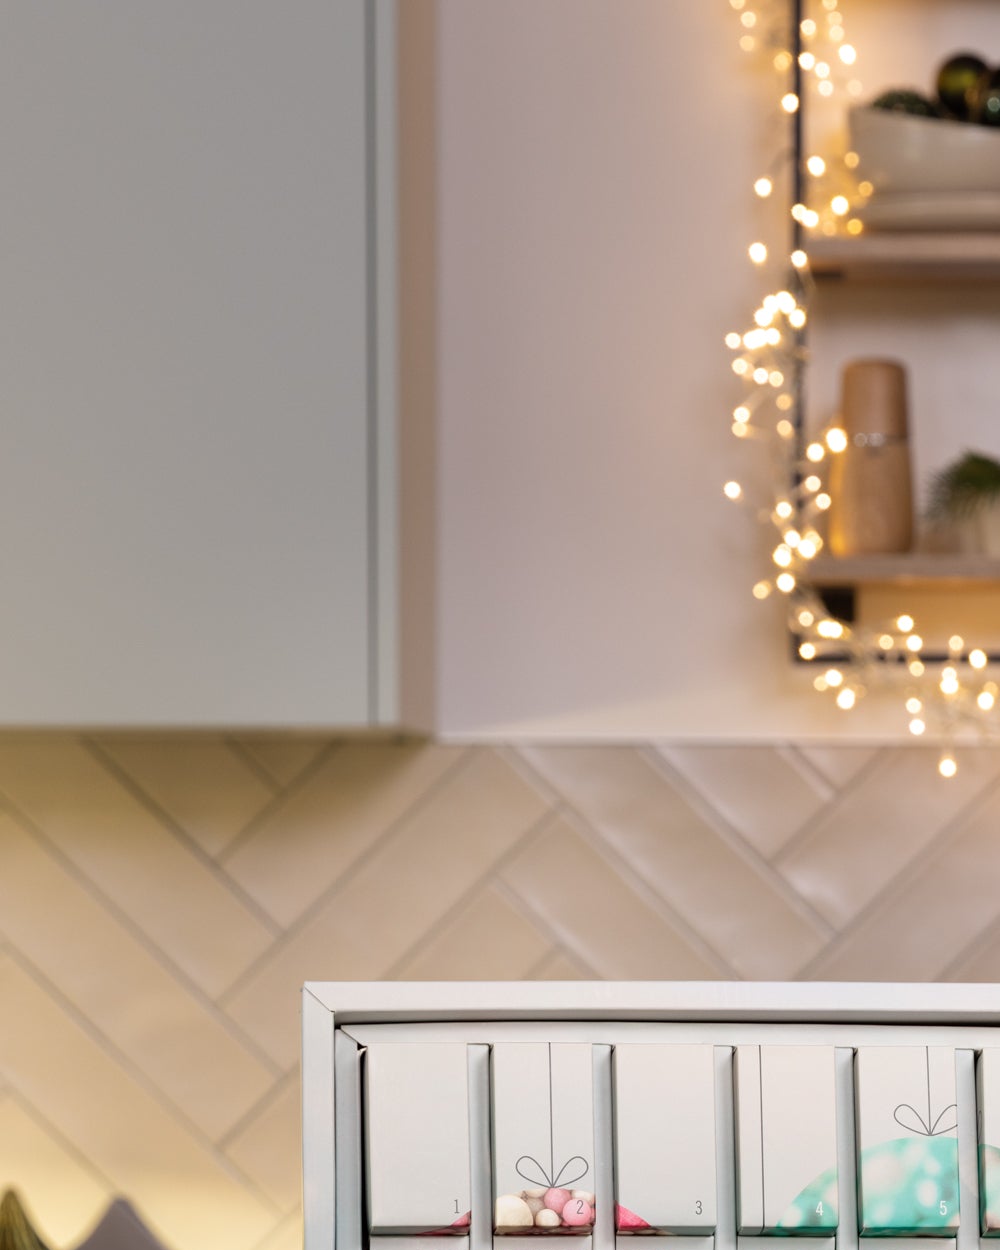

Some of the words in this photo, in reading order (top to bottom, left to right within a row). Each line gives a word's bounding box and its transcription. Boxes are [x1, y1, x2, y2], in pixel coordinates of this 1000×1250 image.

[453, 1199, 460, 1214] 1
[576, 1200, 584, 1215] 2
[695, 1200, 703, 1215] 3
[815, 1201, 824, 1216] 4
[939, 1201, 948, 1216] 5
